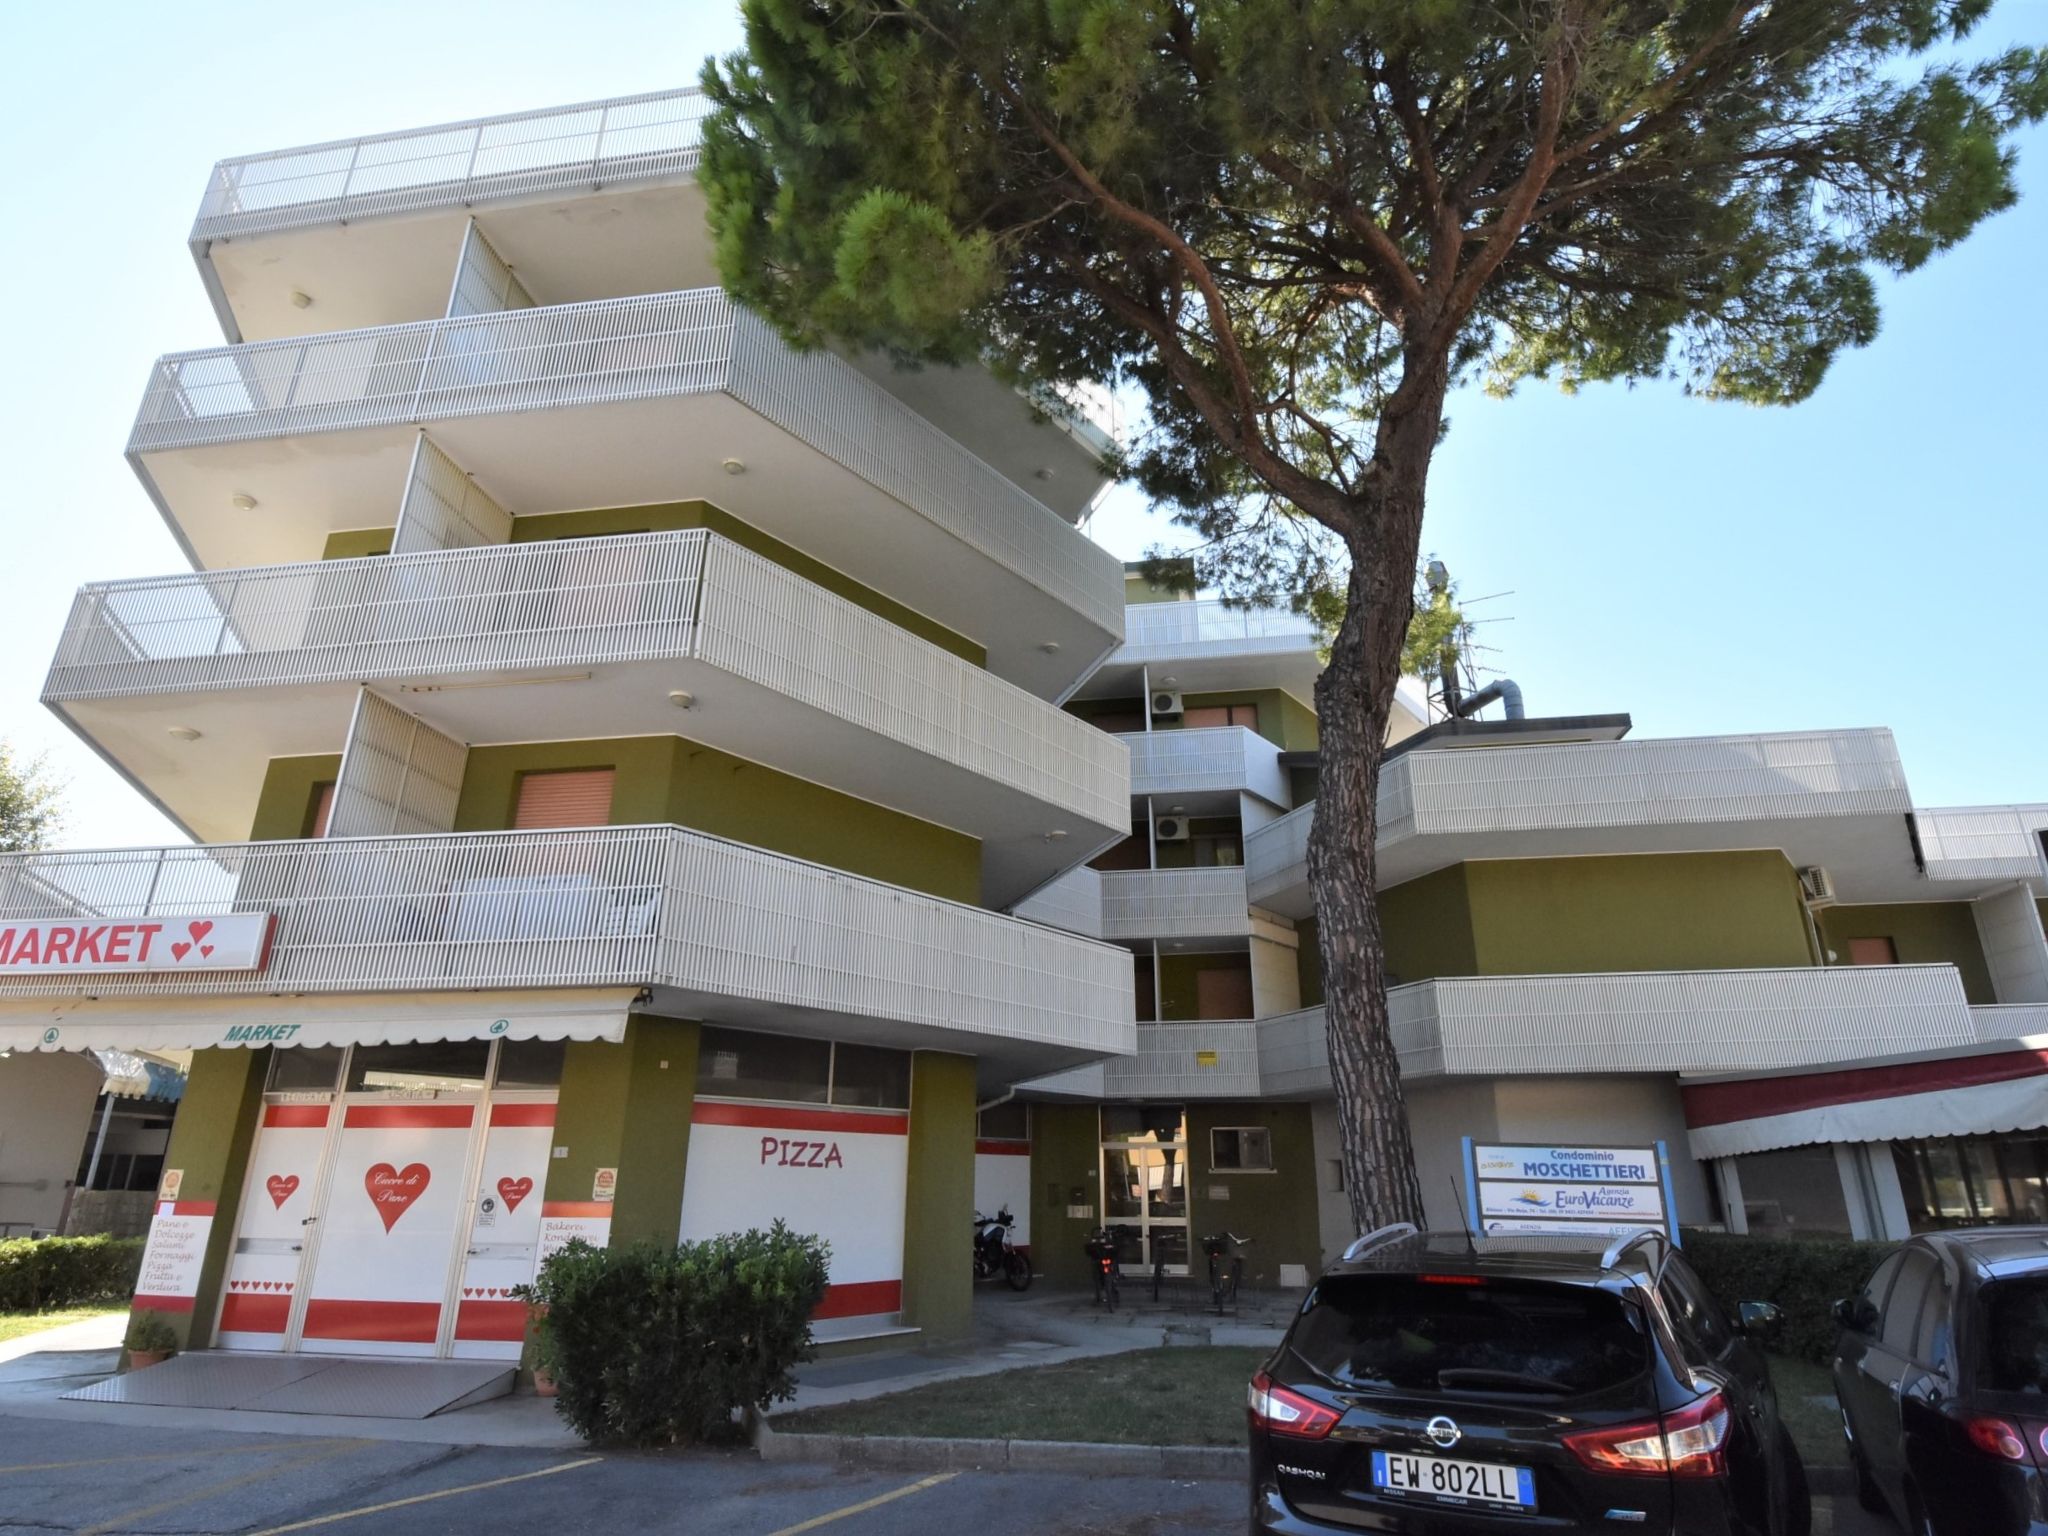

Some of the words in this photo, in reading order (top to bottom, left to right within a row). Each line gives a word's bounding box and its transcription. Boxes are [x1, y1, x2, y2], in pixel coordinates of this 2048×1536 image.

[224, 1024, 300, 1042] MARKET
[760, 1136, 843, 1169] PIZZA
[1550, 1150, 1614, 1161] Condominio
[1523, 1162, 1646, 1179] MOSCHETTIERI
[374, 1172, 404, 1185] Cuore
[376, 1189, 408, 1203] Pane
[1599, 1187, 1630, 1197] Agenzia
[1555, 1190, 1635, 1209] EuroVacanze
[157, 1220, 180, 1228] Pane
[149, 1250, 195, 1263] Formaggi
[147, 1261, 173, 1272] Pizza
[145, 1271, 173, 1280] Frutta
[142, 1282, 181, 1291] Verdura
[1277, 1464, 1326, 1480] QASHQAI
[1389, 1456, 1420, 1488] EW
[1432, 1462, 1516, 1501] 802LL
[1383, 1488, 1405, 1497] NISSAN
